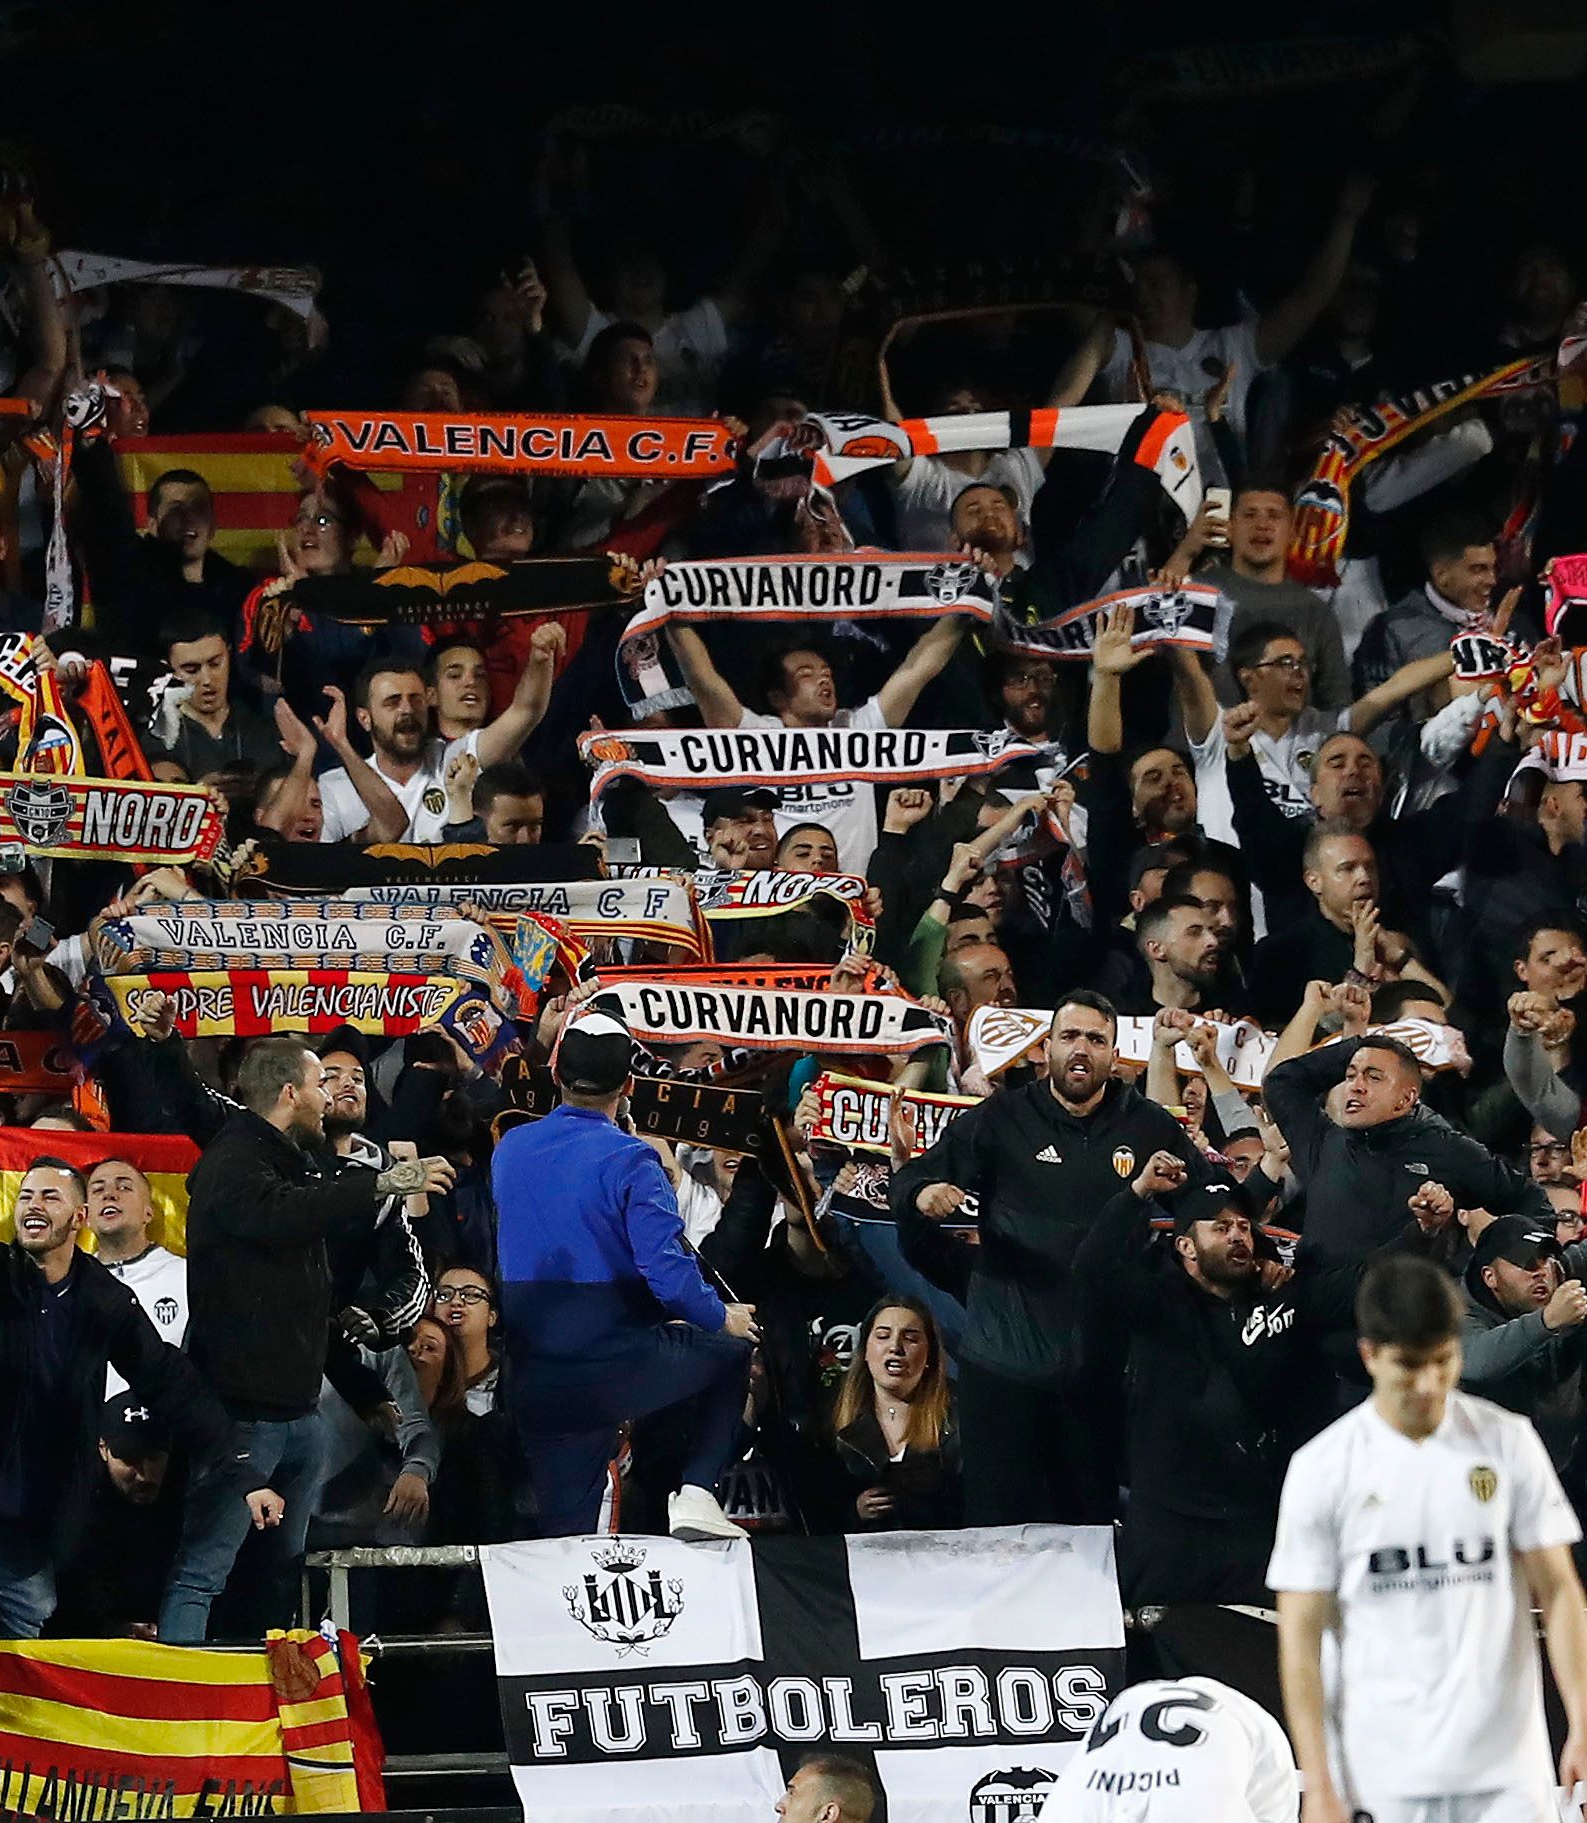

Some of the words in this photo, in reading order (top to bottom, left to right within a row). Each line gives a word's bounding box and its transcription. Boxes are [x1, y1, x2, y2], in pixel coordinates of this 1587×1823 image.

[335, 418, 620, 464] VALENCIA
[628, 429, 720, 465] C.F.
[660, 563, 881, 608] CURVANORD
[679, 731, 926, 773] CURVANORD
[82, 791, 209, 849] NORD
[159, 918, 358, 950] VALENCIA
[385, 925, 446, 951] C.F.
[250, 984, 458, 1020] VALENCIANISTE
[638, 988, 884, 1040] CURVANORD
[1368, 1536, 1494, 1573] BLU
[525, 1664, 1109, 1759] FUTBOLEROS
[1087, 1768, 1181, 1796] PICCINI
